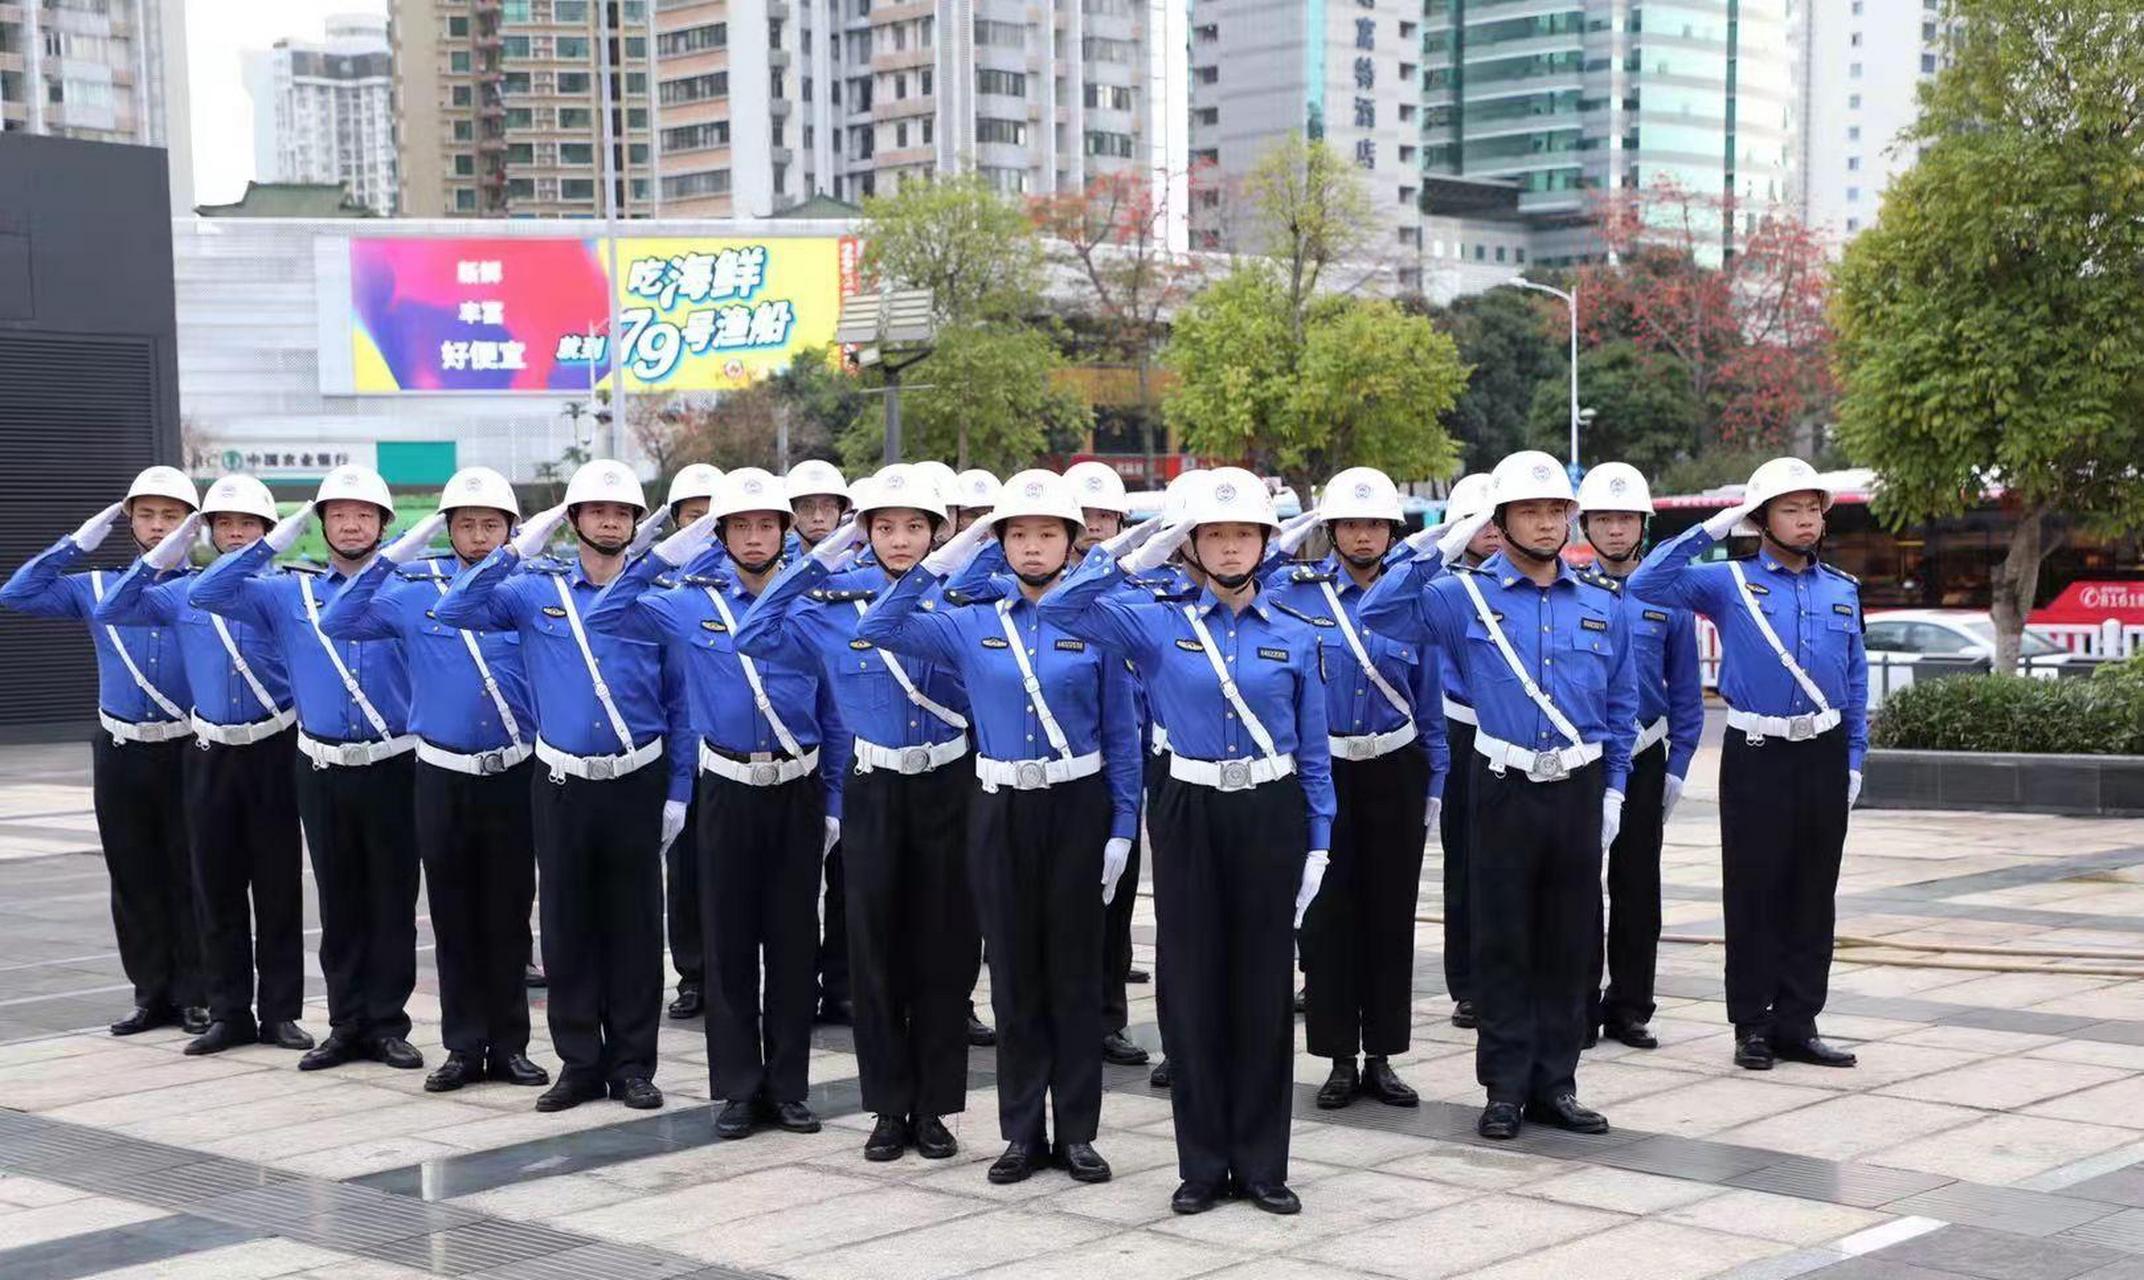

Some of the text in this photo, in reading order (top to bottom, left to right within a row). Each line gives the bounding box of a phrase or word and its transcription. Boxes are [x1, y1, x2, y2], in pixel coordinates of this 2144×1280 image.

[1354, 0, 1376, 170] 富特酒店
[627, 246, 767, 309] 吃海鲜
[441, 341, 527, 370] 好便宜
[247, 453, 349, 467] 中国农业银行
